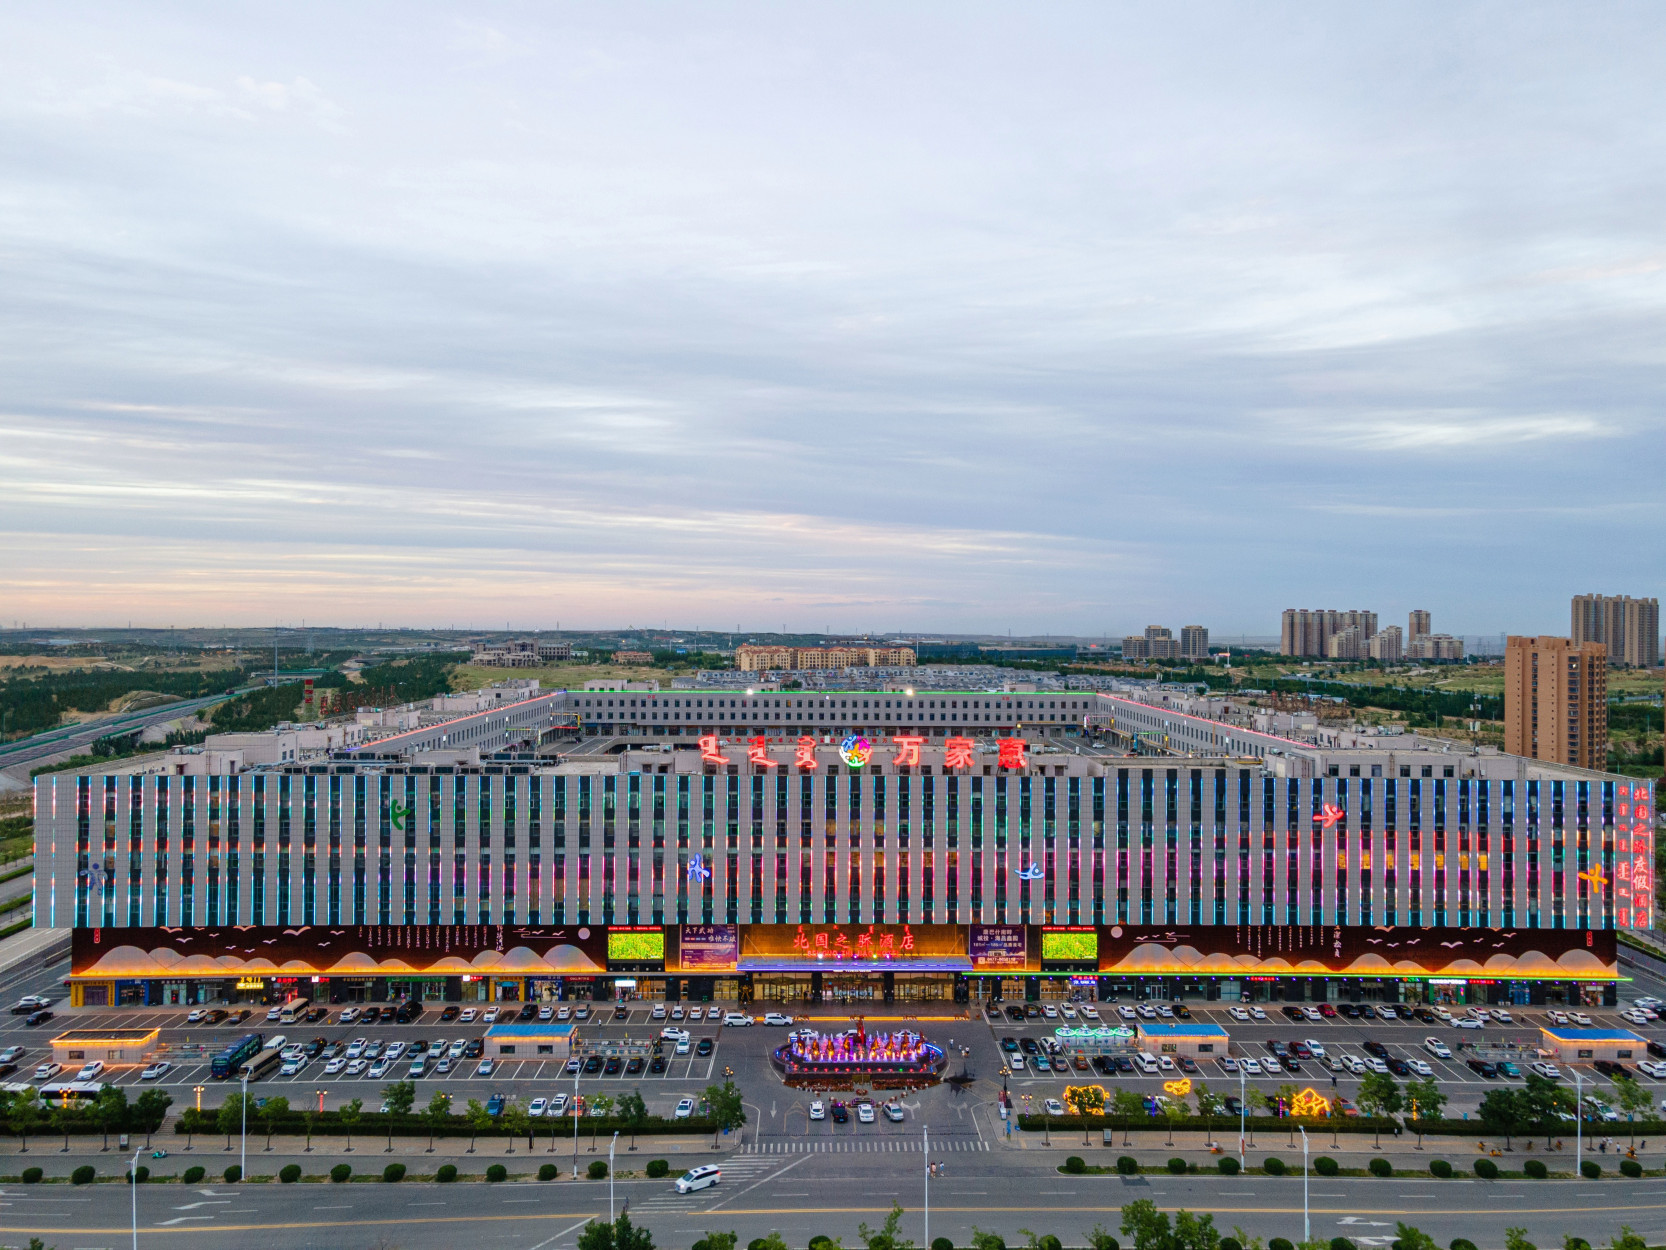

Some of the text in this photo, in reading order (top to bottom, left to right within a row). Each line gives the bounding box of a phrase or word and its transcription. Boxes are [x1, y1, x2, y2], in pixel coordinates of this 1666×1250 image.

[892, 735, 1027, 769] 万家惠
[794, 933, 914, 950] 北国之骄酒店
